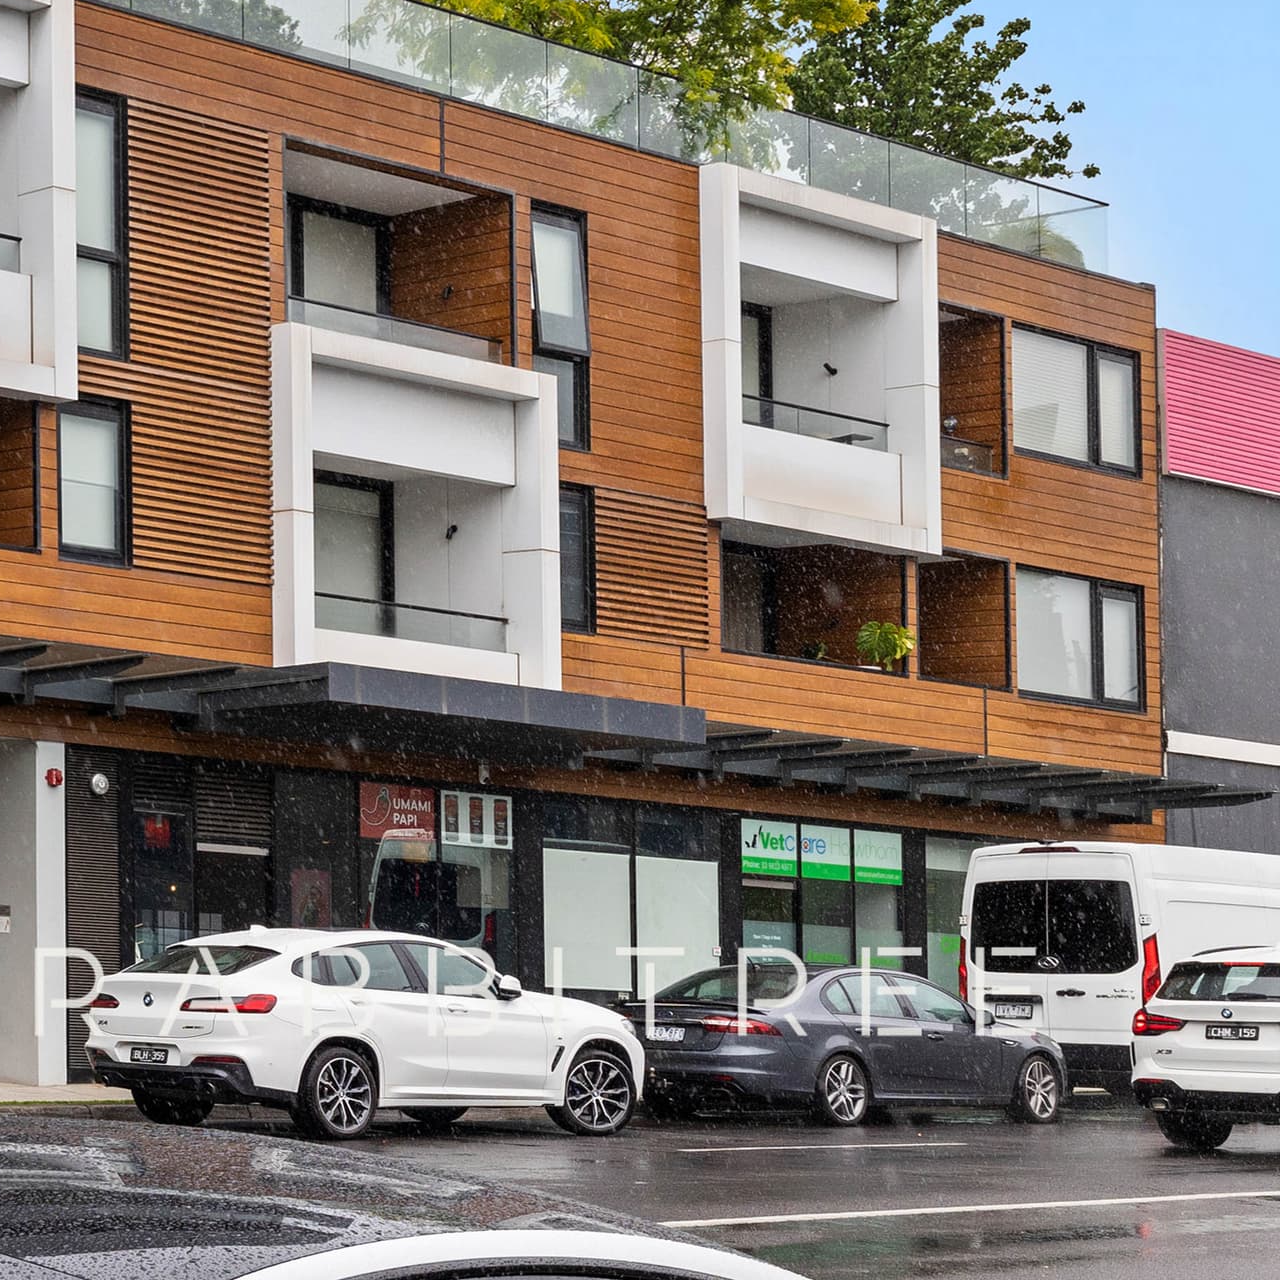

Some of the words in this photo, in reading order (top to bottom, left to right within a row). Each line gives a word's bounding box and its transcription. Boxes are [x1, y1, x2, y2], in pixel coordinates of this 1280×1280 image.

[392, 797, 431, 812] UMAMI
[392, 813, 418, 827] PAPI
[760, 831, 827, 856] VetCare
